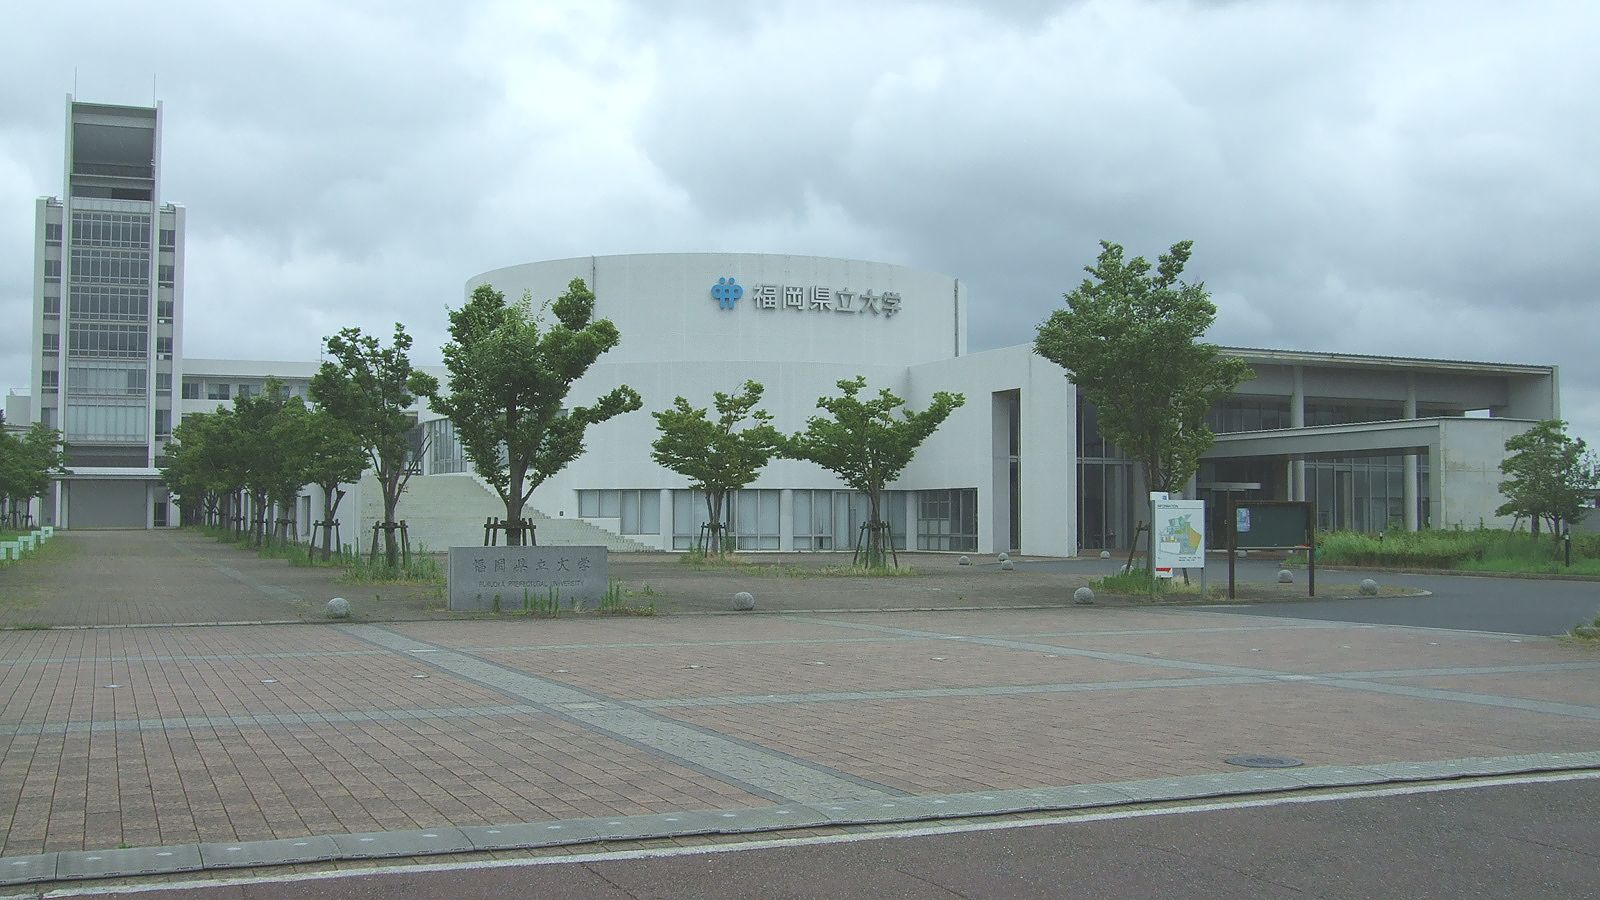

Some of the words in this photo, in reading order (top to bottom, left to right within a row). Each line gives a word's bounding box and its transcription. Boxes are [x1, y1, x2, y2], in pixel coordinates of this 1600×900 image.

[753, 284, 902, 318] 福岡県立大学
[473, 557, 591, 573] 福岡県立大学
